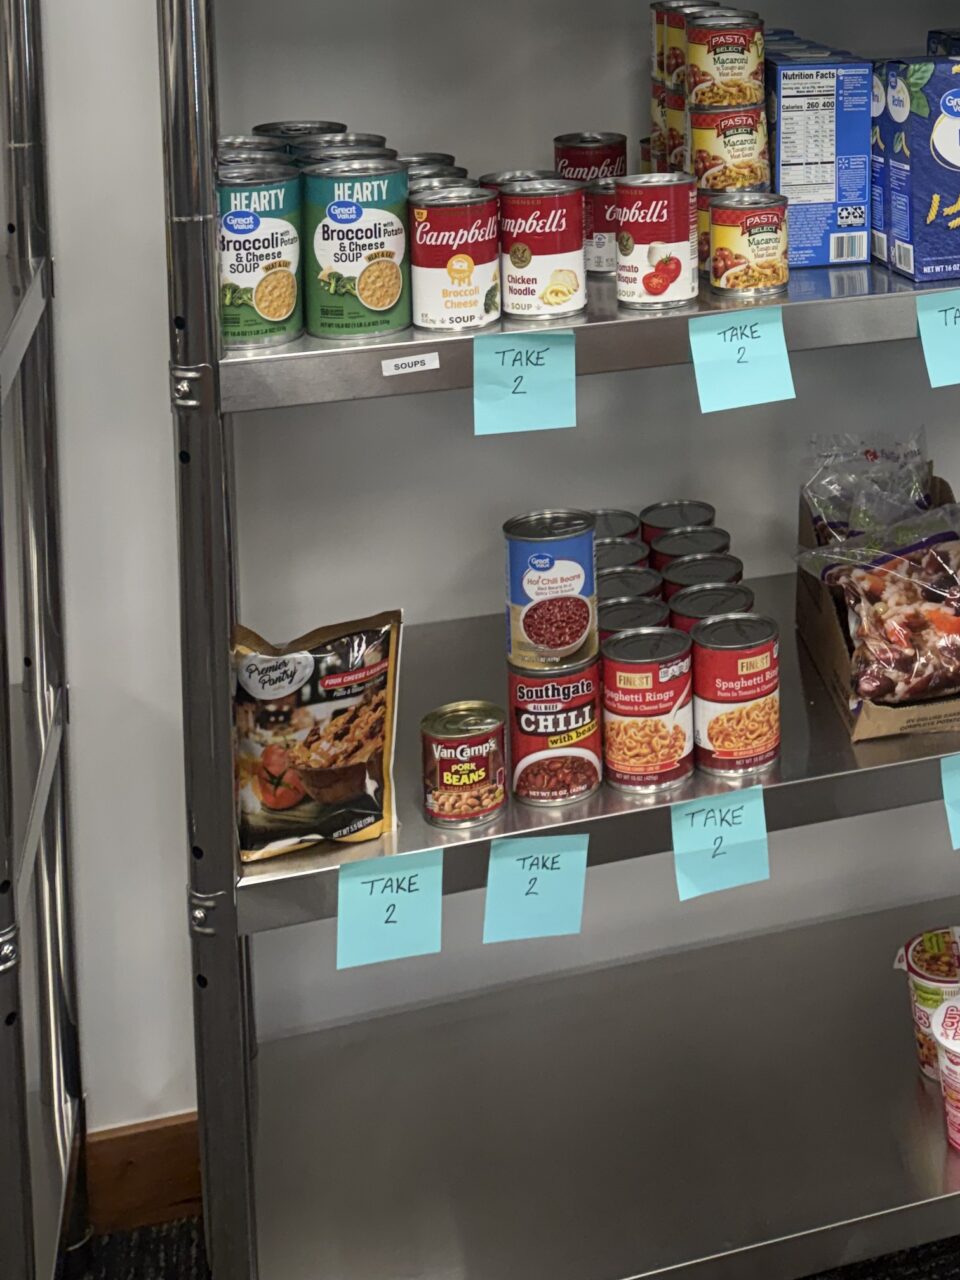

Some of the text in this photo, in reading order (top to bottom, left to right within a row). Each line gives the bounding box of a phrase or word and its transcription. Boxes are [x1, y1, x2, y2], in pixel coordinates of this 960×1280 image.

[710, 36, 746, 45] PASTA
[716, 44, 744, 54] SELECT
[712, 56, 748, 66] Macaroni
[782, 71, 835, 80] Nutrition Facts
[720, 116, 754, 127] PASTA
[723, 138, 756, 148] Macaroni
[334, 180, 388, 202] HEARTY
[230, 189, 285, 211] HEARTY
[330, 206, 357, 215] Great
[226, 215, 254, 225] Great
[746, 214, 778, 226] PASTA
[322, 222, 381, 241] Broccoli
[339, 241, 385, 252] & Cheese
[235, 250, 282, 263] & Cheese
[333, 253, 362, 263] SOUP
[229, 263, 260, 274] SOUP
[507, 274, 537, 285] Chicken
[442, 287, 479, 298] Broccoli
[509, 284, 536, 296] Noodle
[444, 298, 479, 309] Cheese
[449, 315, 475, 324] SOUP
[717, 325, 761, 342] TAKE
[495, 347, 550, 369] TAKE
[736, 346, 750, 365] 2
[394, 359, 426, 371] SOUPS
[511, 375, 527, 396] 2
[245, 659, 289, 679] Premier
[740, 655, 770, 672] FINEST
[259, 667, 297, 691] Pantry
[618, 675, 650, 687] FINEST
[517, 679, 593, 702] Southgate
[520, 704, 592, 733] CHILI
[451, 763, 476, 772] PORK
[443, 769, 486, 786] BEANS
[685, 806, 744, 828] TAKE
[711, 836, 727, 859] 2
[516, 854, 561, 872] TAKE
[360, 874, 420, 895] TAKE
[525, 878, 540, 896] 2
[384, 904, 397, 925] 2
[942, 1006, 960, 1032] CUP
